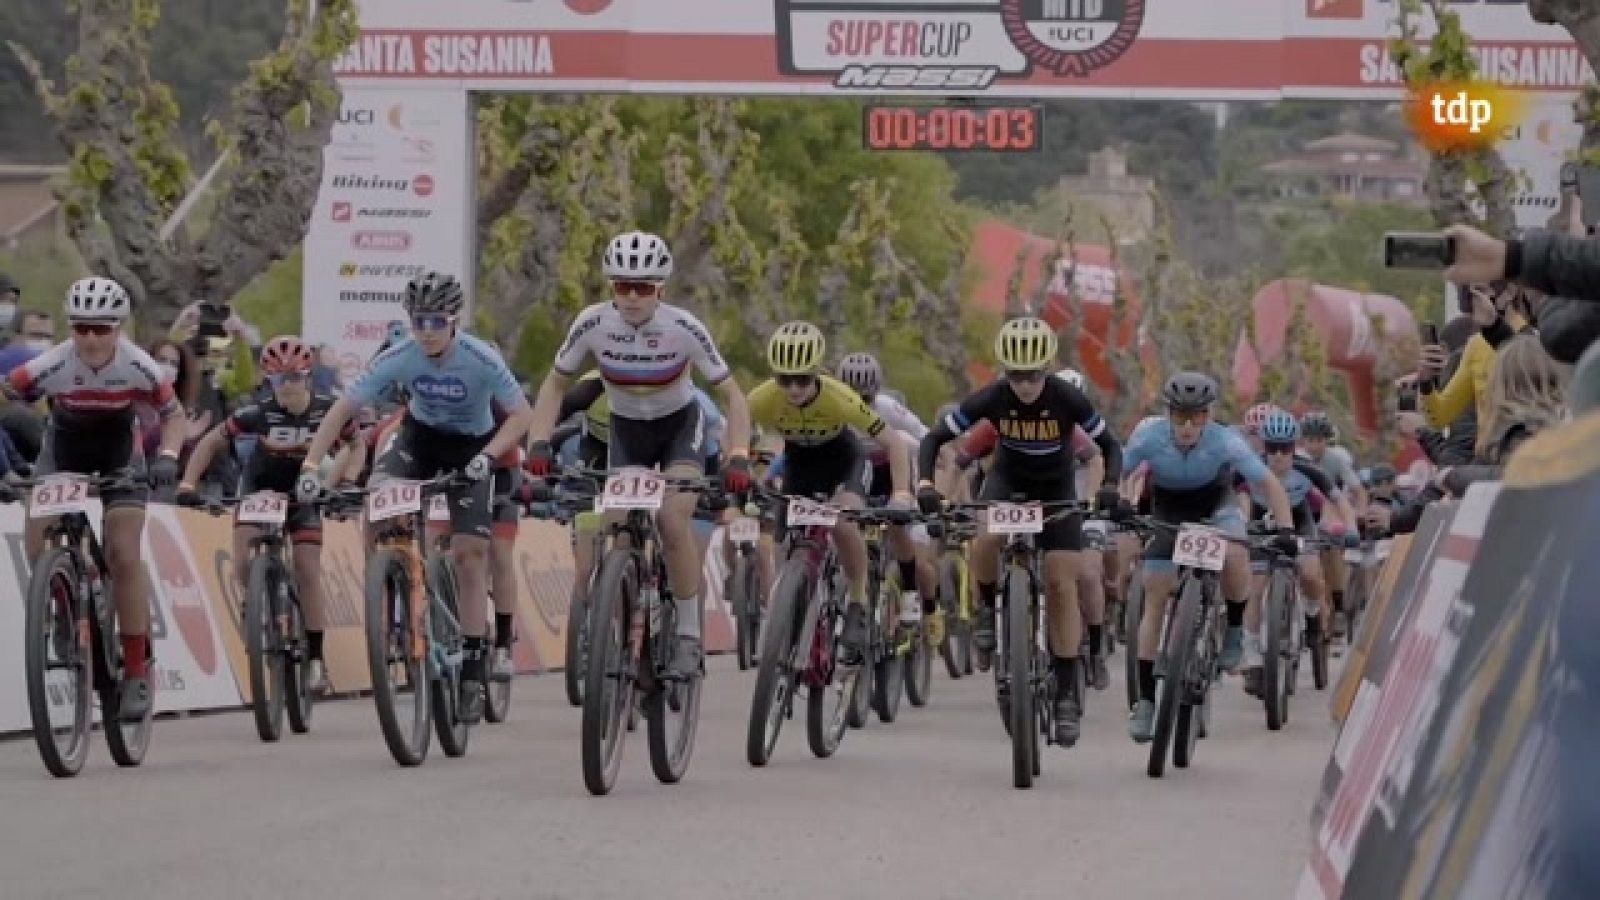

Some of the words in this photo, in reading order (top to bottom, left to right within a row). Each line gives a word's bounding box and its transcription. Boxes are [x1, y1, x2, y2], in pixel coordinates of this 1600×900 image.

[826, 20, 971, 57] SUPERCUP
[424, 35, 554, 73] SUSANNA
[868, 106, 1035, 149] 00:00:03
[36, 485, 81, 505] 612
[610, 477, 660, 496] 619
[244, 498, 283, 513] 624
[373, 487, 416, 511] 610
[992, 504, 1037, 523] 603
[1180, 533, 1222, 558] 692
